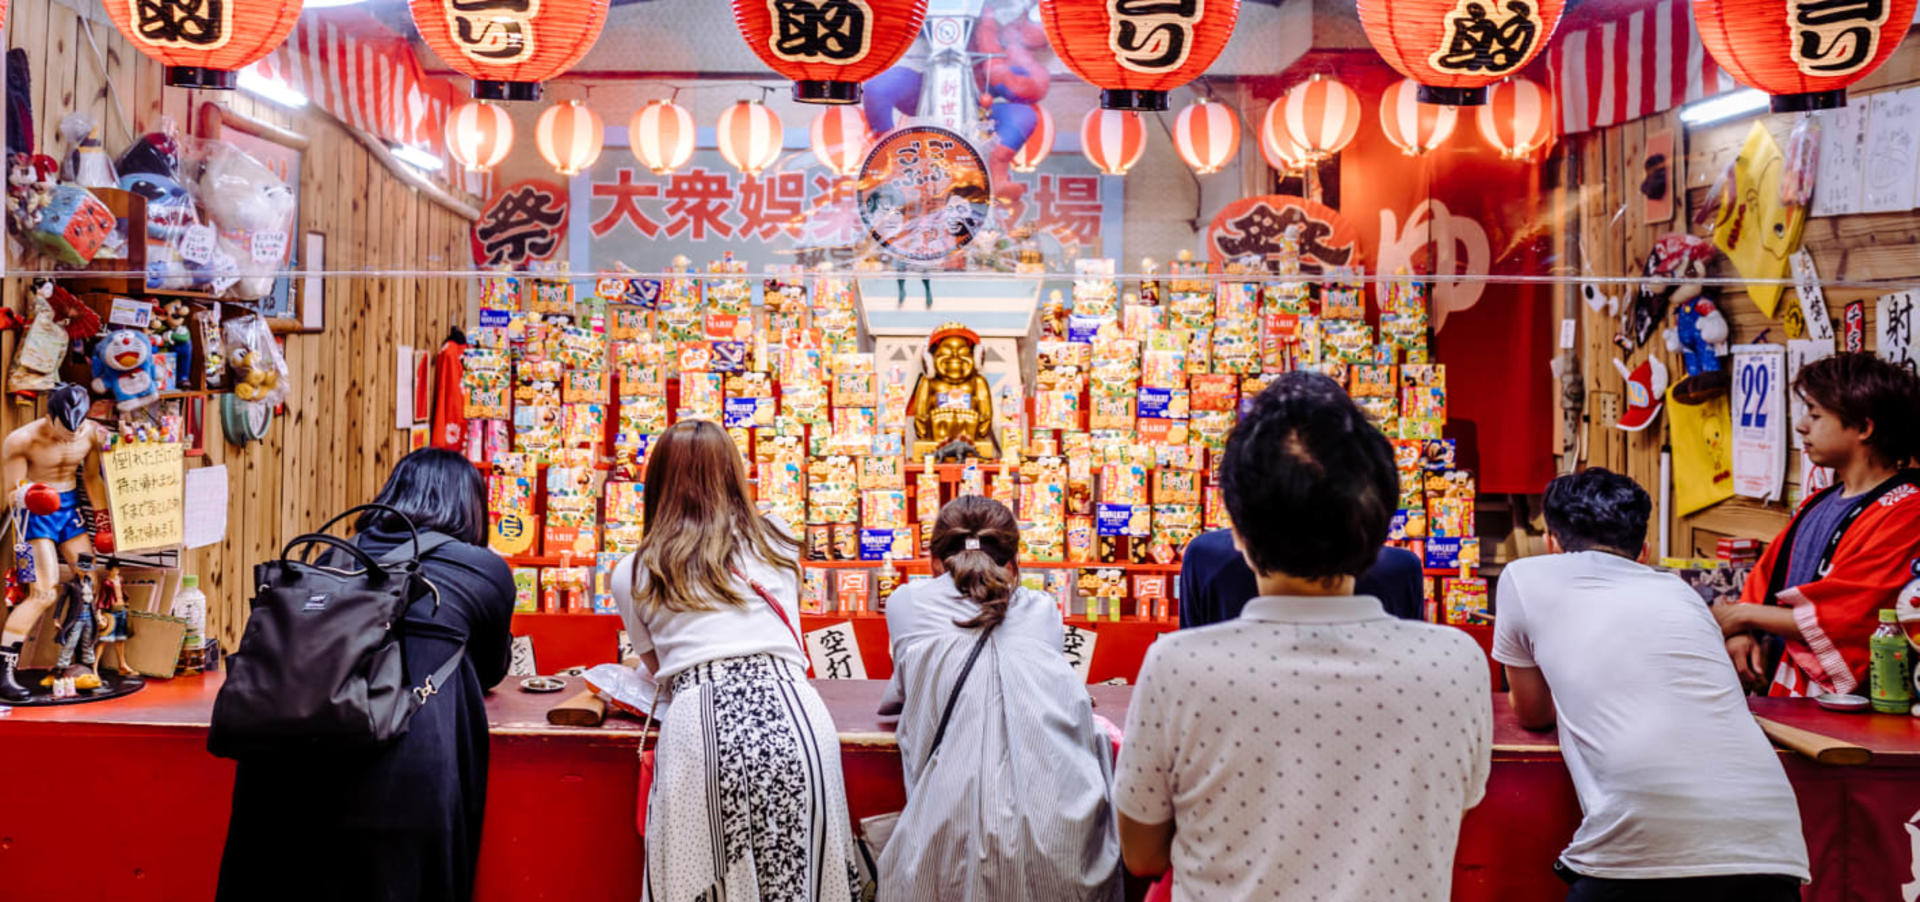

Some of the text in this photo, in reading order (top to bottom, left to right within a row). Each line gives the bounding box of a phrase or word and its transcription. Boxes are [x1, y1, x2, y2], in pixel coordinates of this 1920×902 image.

[708, 320, 733, 328] MARIE
[1741, 364, 1769, 428] 22
[546, 533, 574, 542] MARIE
